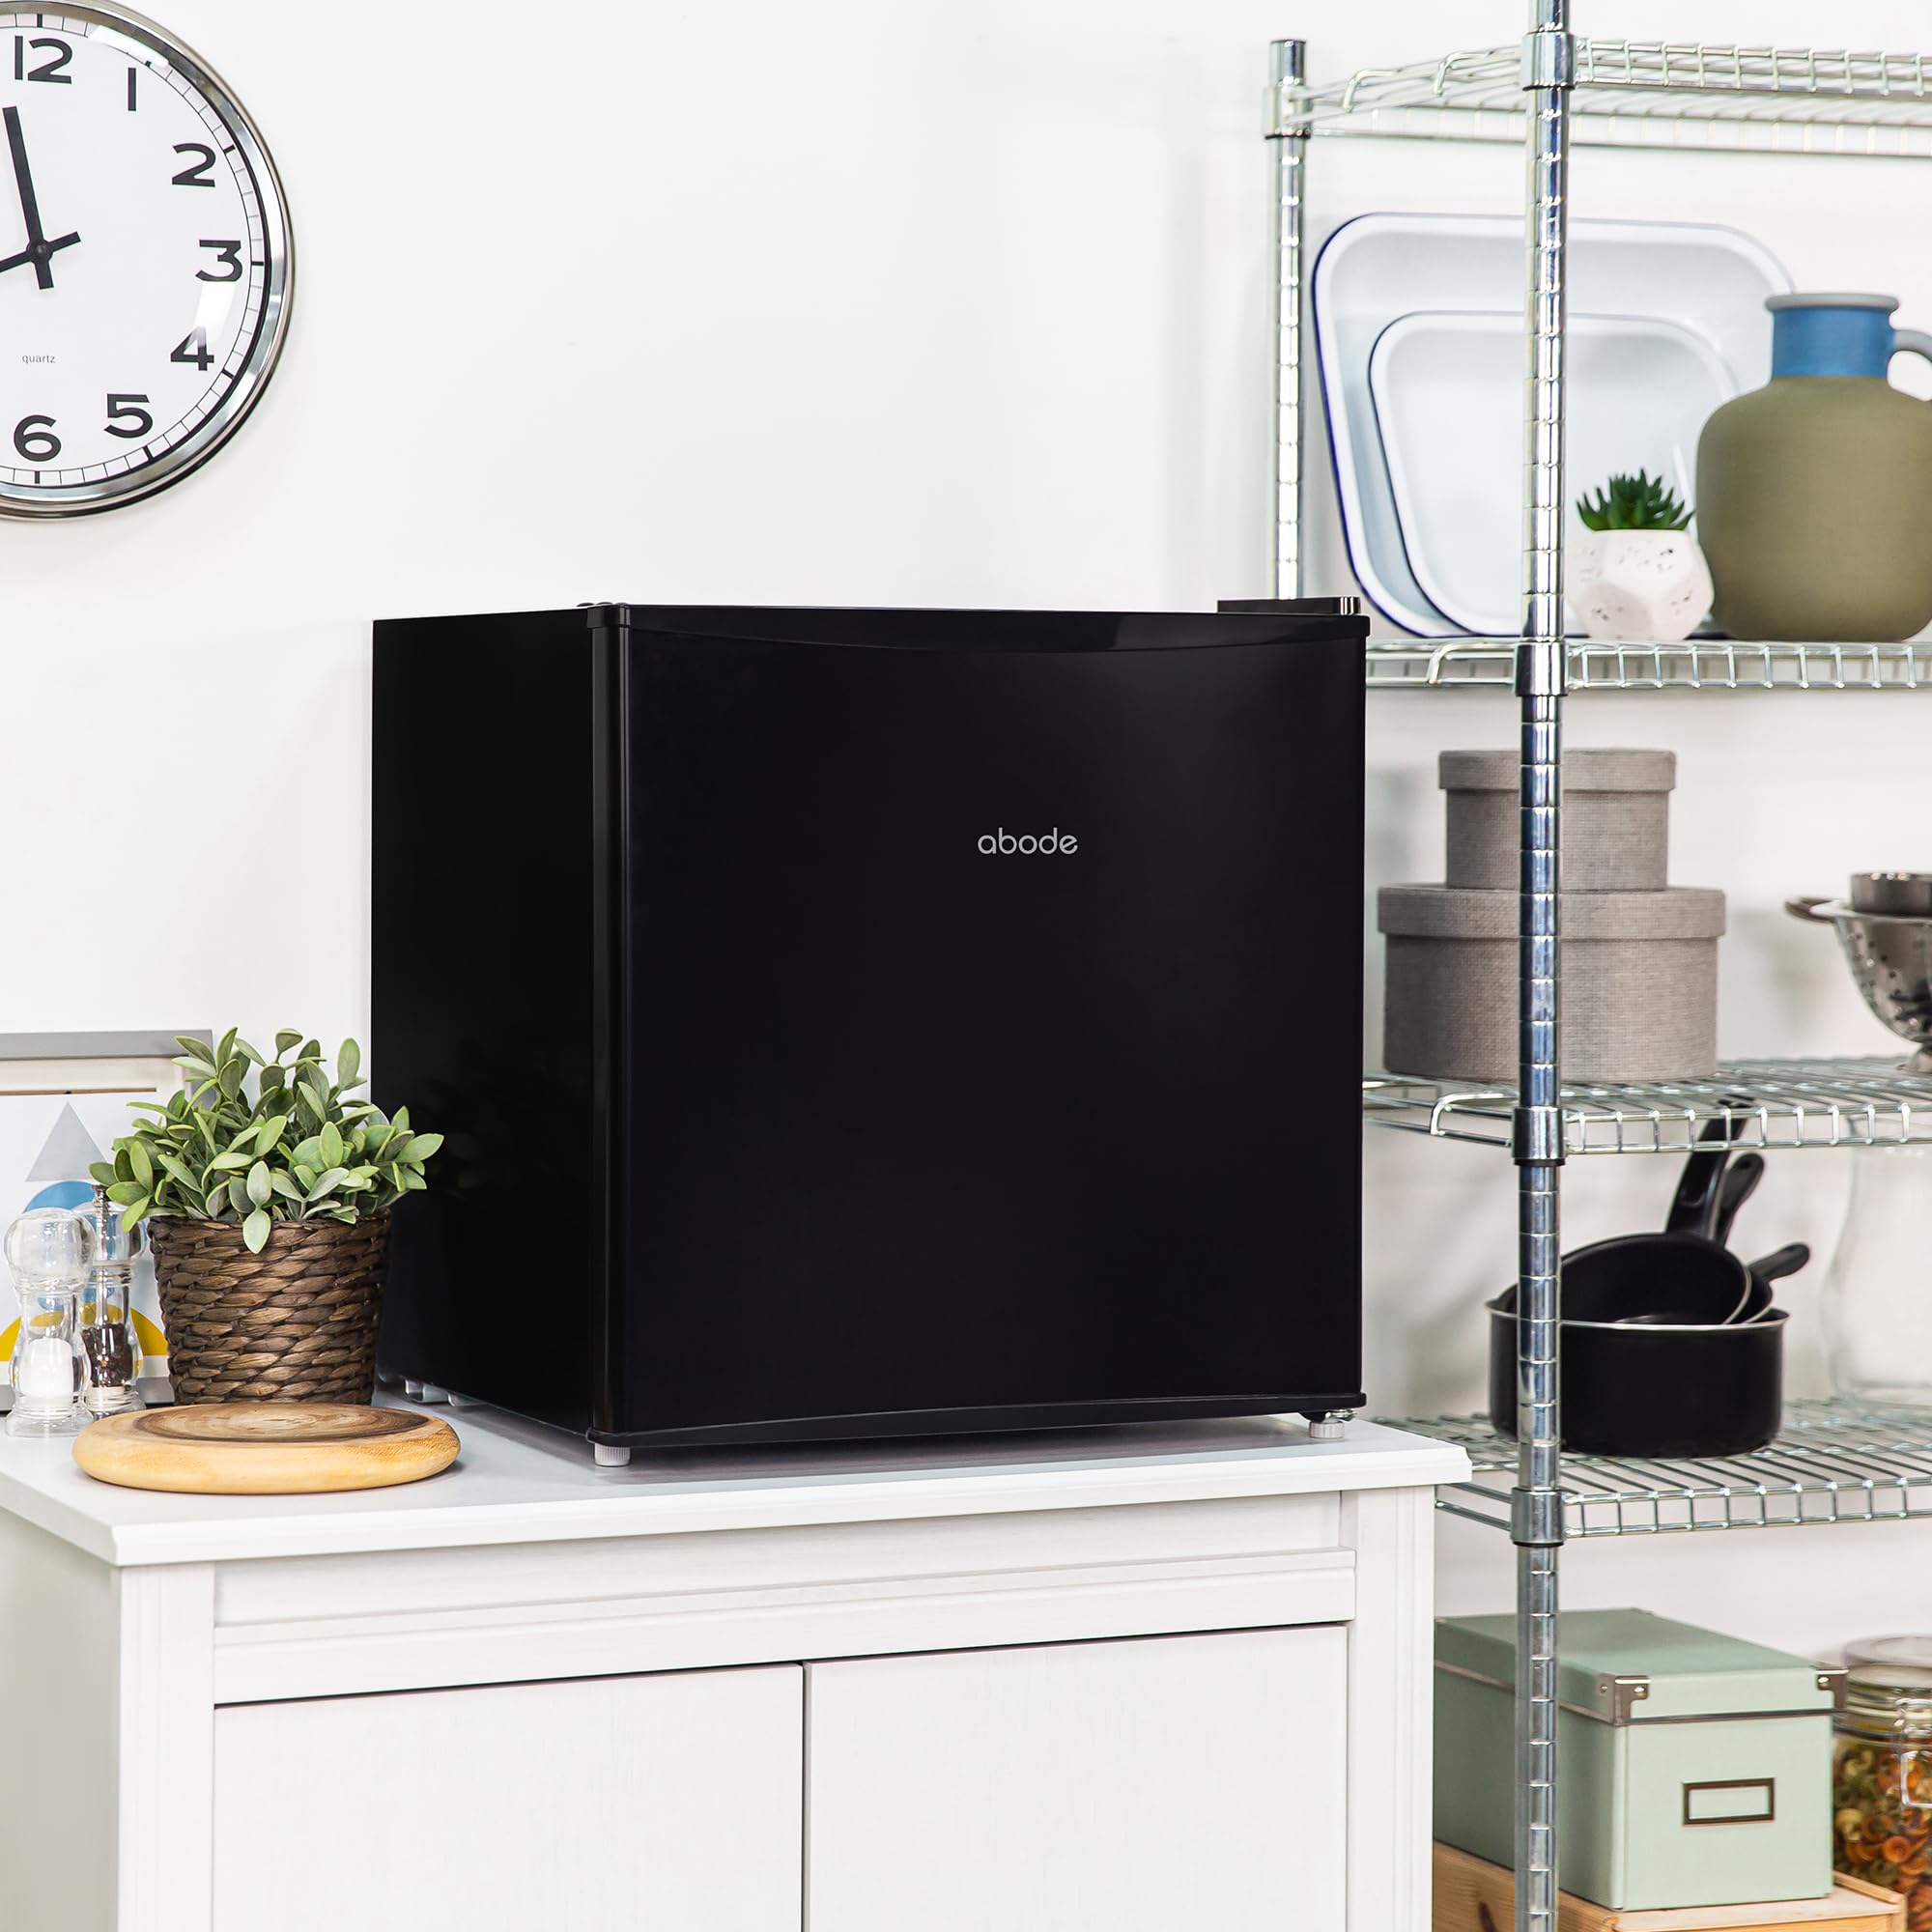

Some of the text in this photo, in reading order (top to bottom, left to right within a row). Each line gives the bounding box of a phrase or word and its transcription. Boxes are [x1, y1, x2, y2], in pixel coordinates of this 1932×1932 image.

[14, 35, 72, 84] 12
[128, 67, 137, 112] 1
[171, 143, 216, 187] 2
[195, 239, 243, 282] 3
[21, 355, 56, 364] quartz
[170, 327, 214, 372] 4
[14, 414, 62, 463] 6
[103, 393, 154, 439] 5
[978, 827, 1079, 855] abode
